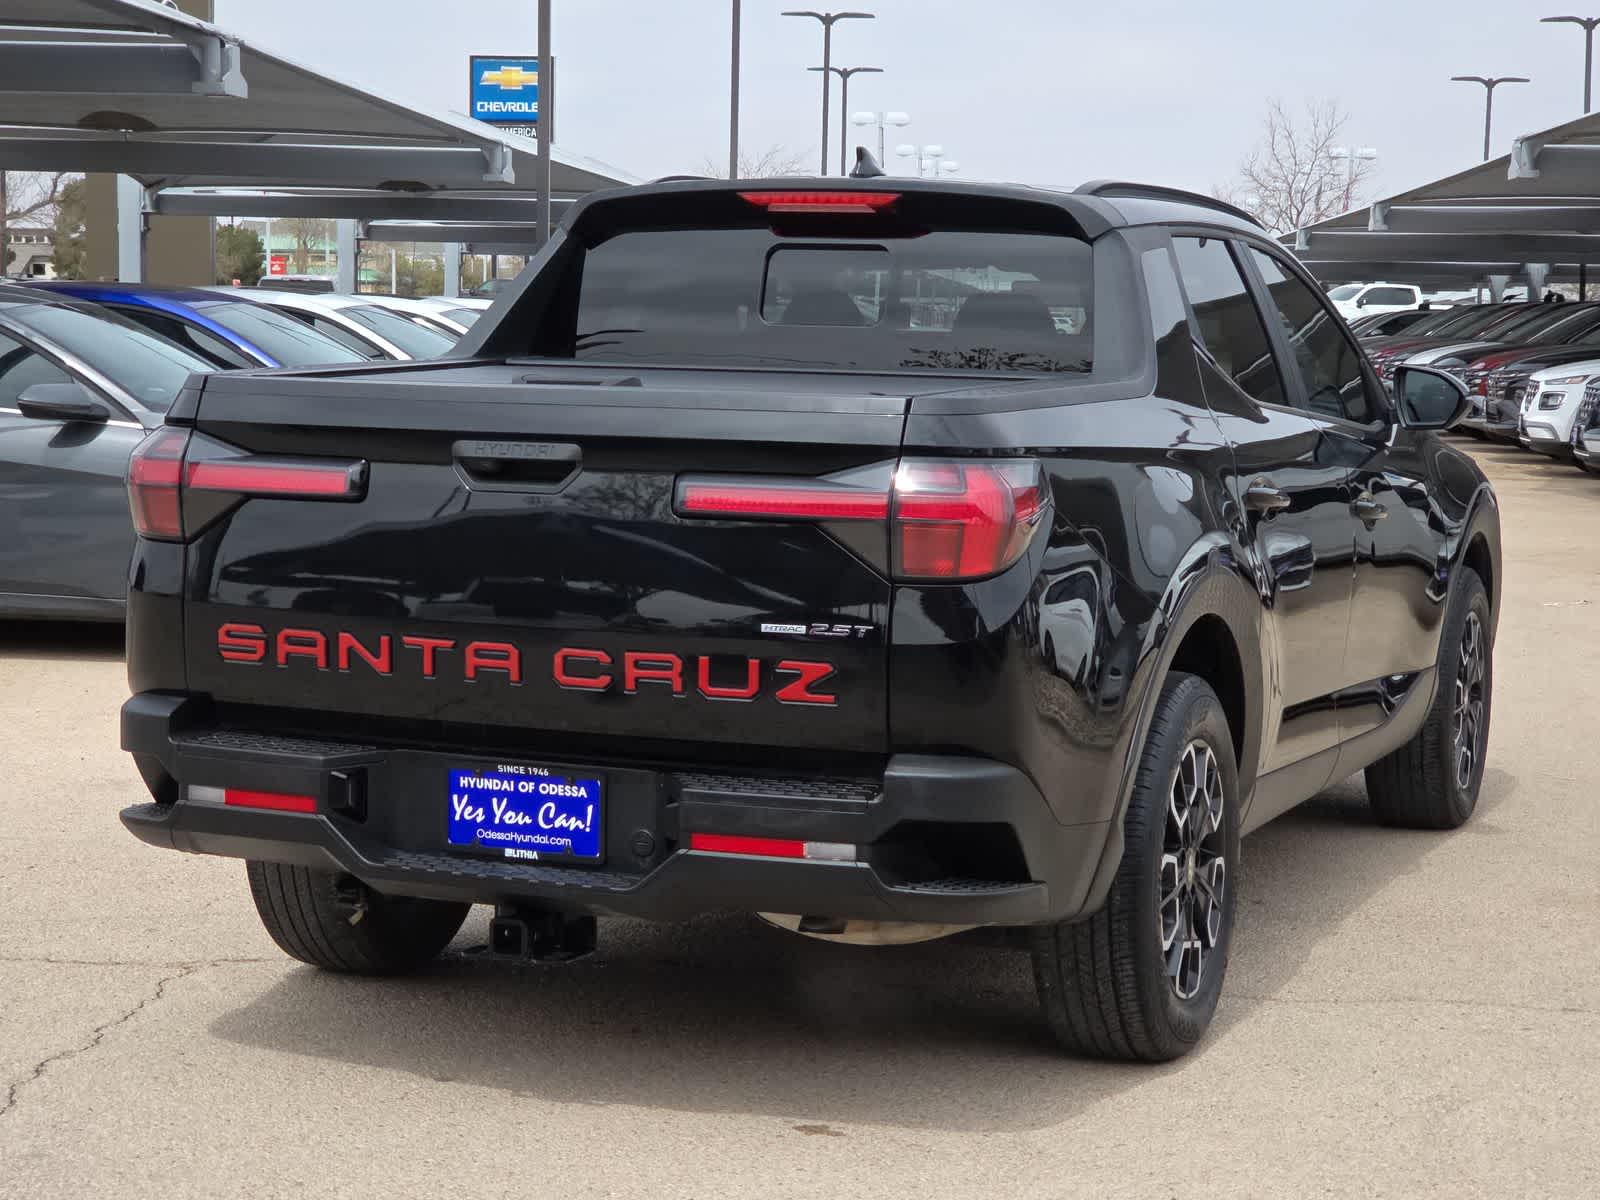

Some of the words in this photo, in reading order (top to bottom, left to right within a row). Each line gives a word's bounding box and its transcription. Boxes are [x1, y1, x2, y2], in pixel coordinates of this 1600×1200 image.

[477, 101, 538, 112] CHEVROLE
[474, 441, 556, 458] HYUNDAI
[762, 624, 805, 633] HTRAC
[217, 622, 523, 687] SANTA
[552, 647, 839, 707] CRUZ
[497, 764, 526, 775] SINCE
[528, 767, 550, 777] 1946
[459, 776, 514, 792] HYUNDAI
[518, 781, 536, 793] OF
[538, 783, 588, 799] ODESSA
[452, 794, 486, 824] Yes
[491, 796, 533, 826] You
[537, 801, 594, 833] Can!
[476, 828, 572, 848] OdessaHyundai.com
[511, 849, 539, 860] LITHIA
